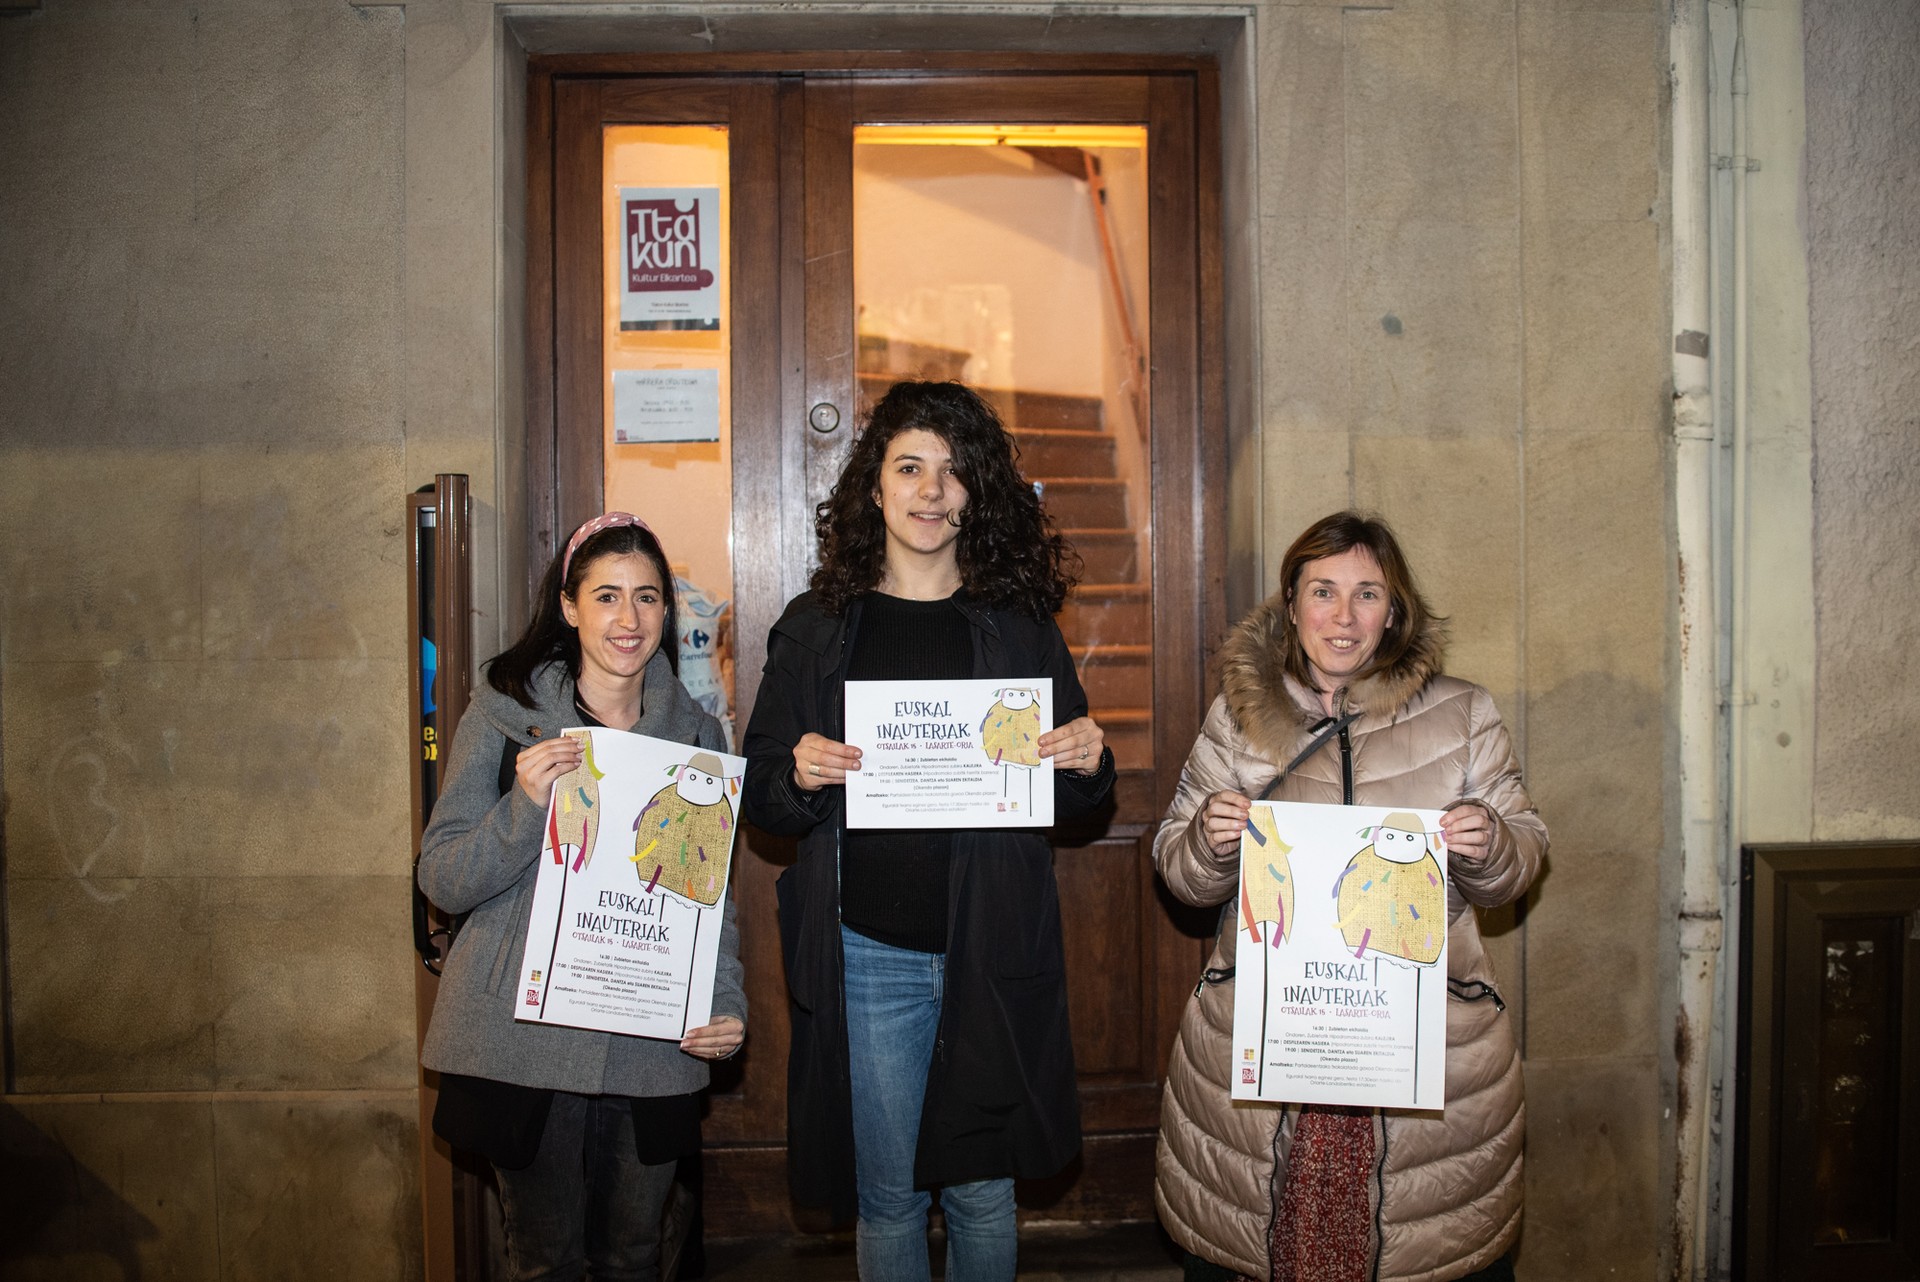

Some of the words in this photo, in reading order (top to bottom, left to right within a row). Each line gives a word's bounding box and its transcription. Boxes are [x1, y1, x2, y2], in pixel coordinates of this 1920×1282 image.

[630, 208, 696, 244] Tta
[631, 232, 697, 270] kun
[632, 274, 658, 282] Kultur
[660, 274, 698, 282] Elkartea
[894, 700, 952, 717] EUSKAL
[876, 722, 970, 740] INAUTERIAK
[876, 742, 909, 750] OTSAILAK
[926, 742, 974, 750] LASARTE-ORIA
[598, 890, 655, 916] EUSKAL
[576, 912, 670, 942] INAUTERIAK
[572, 931, 606, 944] OTSAILAK
[622, 939, 670, 955] LASARTE-ORIA
[1304, 962, 1367, 981] EUSKAL
[1284, 985, 1388, 1007] INAUTERIAK
[1281, 1006, 1317, 1016] OTSAILAK
[1336, 1008, 1390, 1019] LASARTE-ORIA
